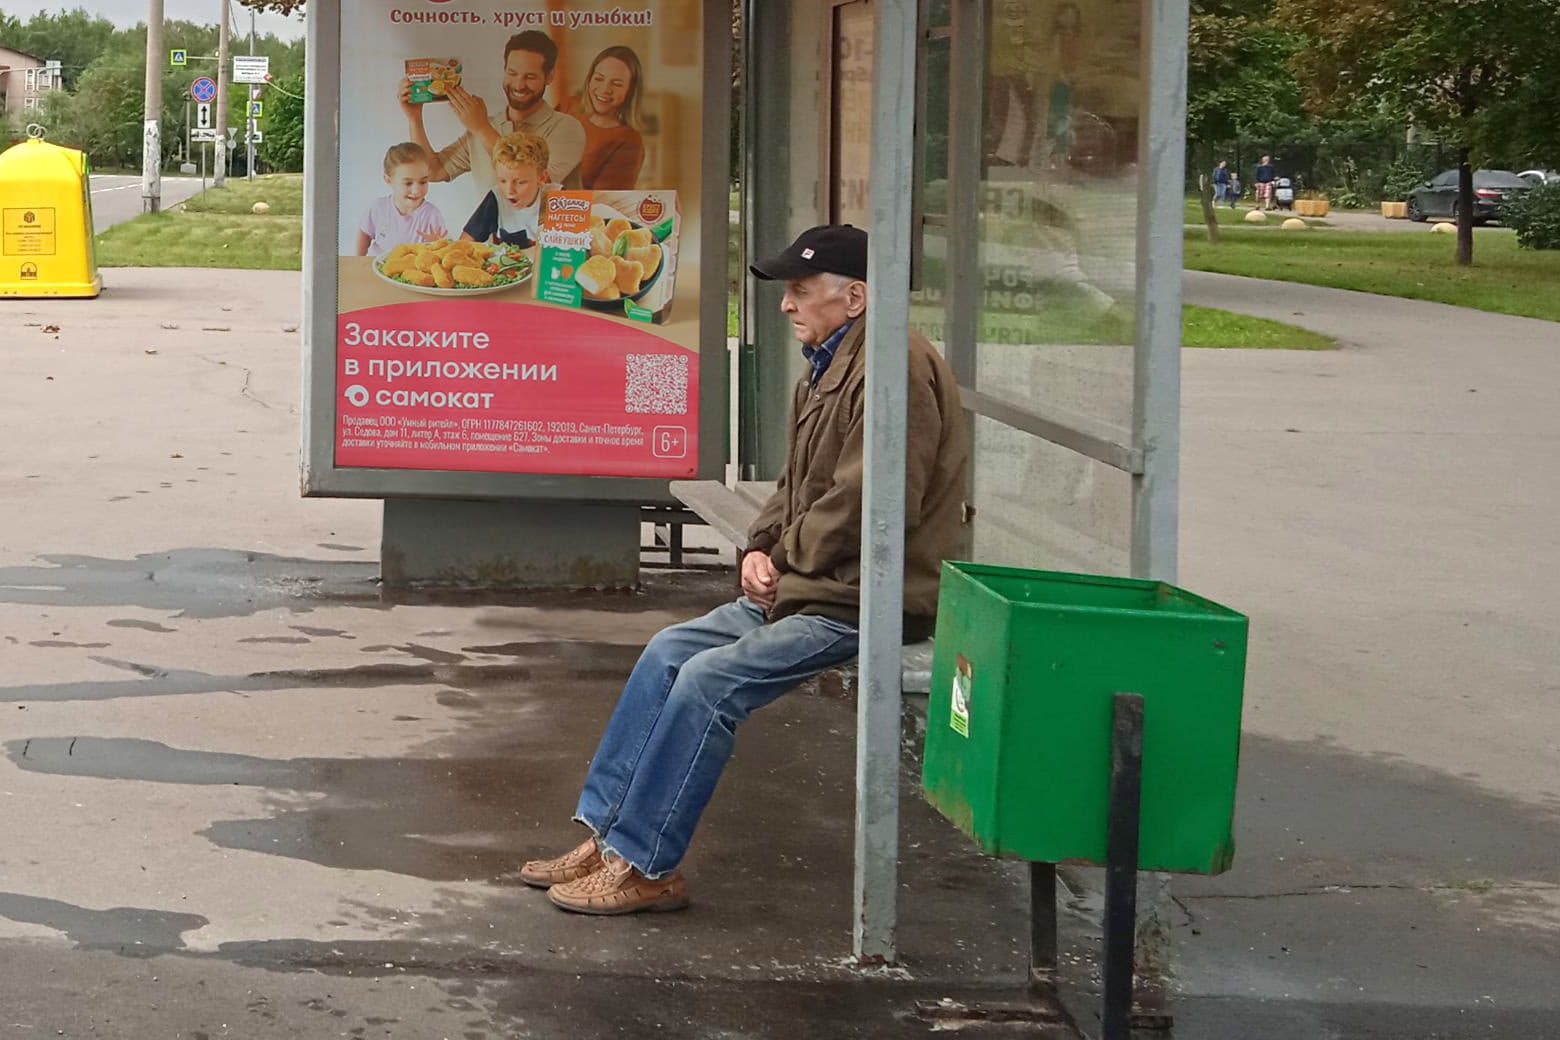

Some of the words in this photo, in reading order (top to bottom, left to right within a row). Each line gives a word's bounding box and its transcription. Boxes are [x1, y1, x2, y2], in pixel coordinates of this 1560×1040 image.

[390, 9, 486, 25] Сочность,
[493, 10, 545, 27] хруст
[551, 10, 564, 25] и
[569, 8, 652, 28] улыбки!
[344, 322, 490, 349] Закажите
[344, 359, 360, 376] в
[368, 359, 558, 382] приложении
[375, 388, 494, 409] самокат
[342, 415, 379, 427] Продавец
[379, 416, 396, 427] ООО
[461, 419, 481, 429] ОГРН
[342, 439, 375, 448] доставки
[376, 439, 413, 449] уточняйте
[420, 440, 461, 450] мобильном
[462, 444, 507, 452] приложении
[384, 429, 398, 439] дом
[443, 431, 461, 439] этаж
[470, 433, 512, 442] помещение
[513, 431, 530, 442] 627.
[531, 432, 552, 442] Зоны
[553, 434, 587, 444] доставки
[595, 437, 620, 445] точное
[621, 437, 644, 447] время
[660, 431, 680, 452] 6+
